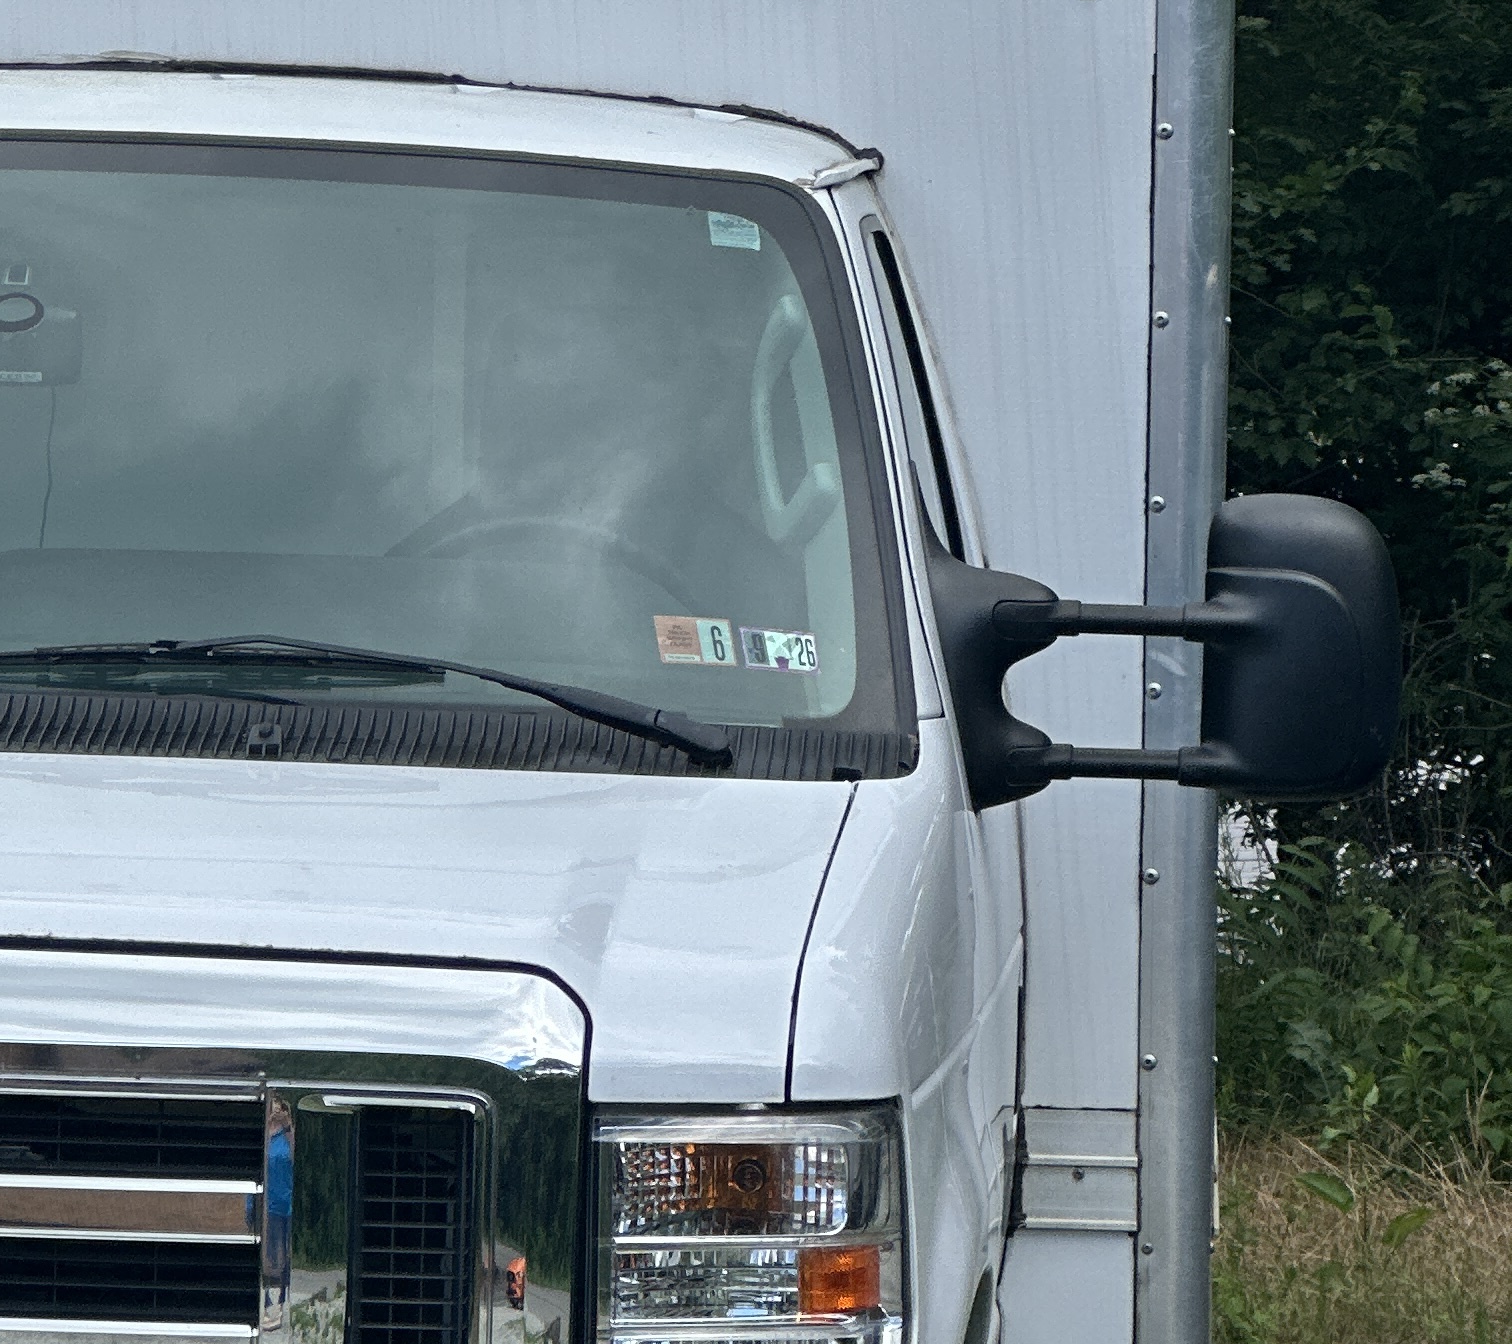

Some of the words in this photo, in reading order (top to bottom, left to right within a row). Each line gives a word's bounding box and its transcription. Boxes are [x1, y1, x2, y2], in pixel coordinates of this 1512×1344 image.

[710, 625, 726, 661] 6
[752, 632, 766, 663] 9
[794, 637, 816, 667] 26
